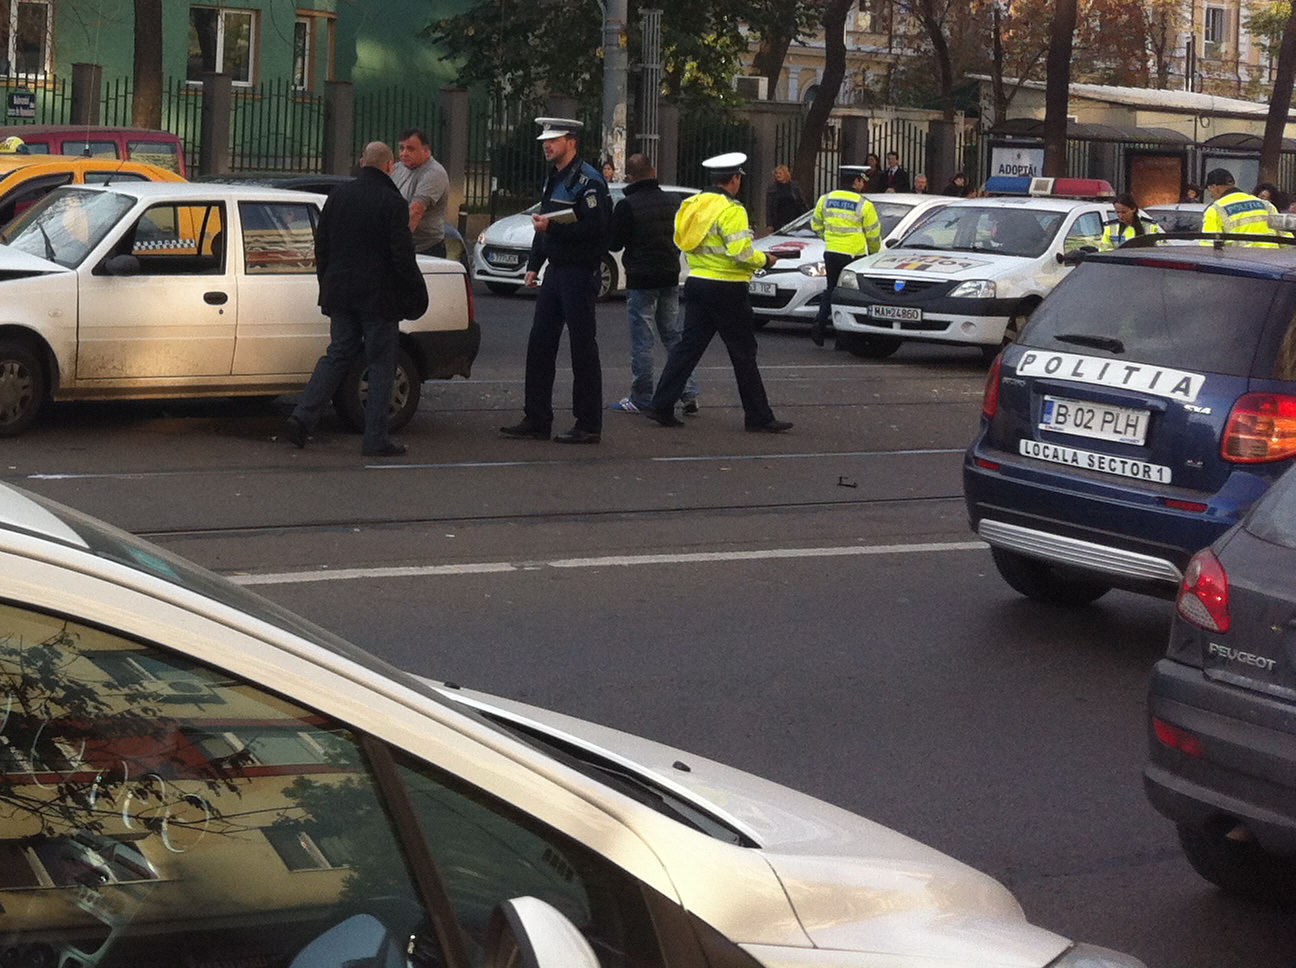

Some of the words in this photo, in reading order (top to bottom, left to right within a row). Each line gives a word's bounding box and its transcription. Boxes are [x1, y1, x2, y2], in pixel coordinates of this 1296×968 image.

[1019, 354, 1192, 396] POLITIA
[1100, 411, 1139, 437] PLH
[1025, 441, 1079, 465] LOCALA
[1087, 454, 1151, 479] SECTOR
[1156, 467, 1163, 481] 1
[1209, 642, 1276, 671] PEUGEOT
